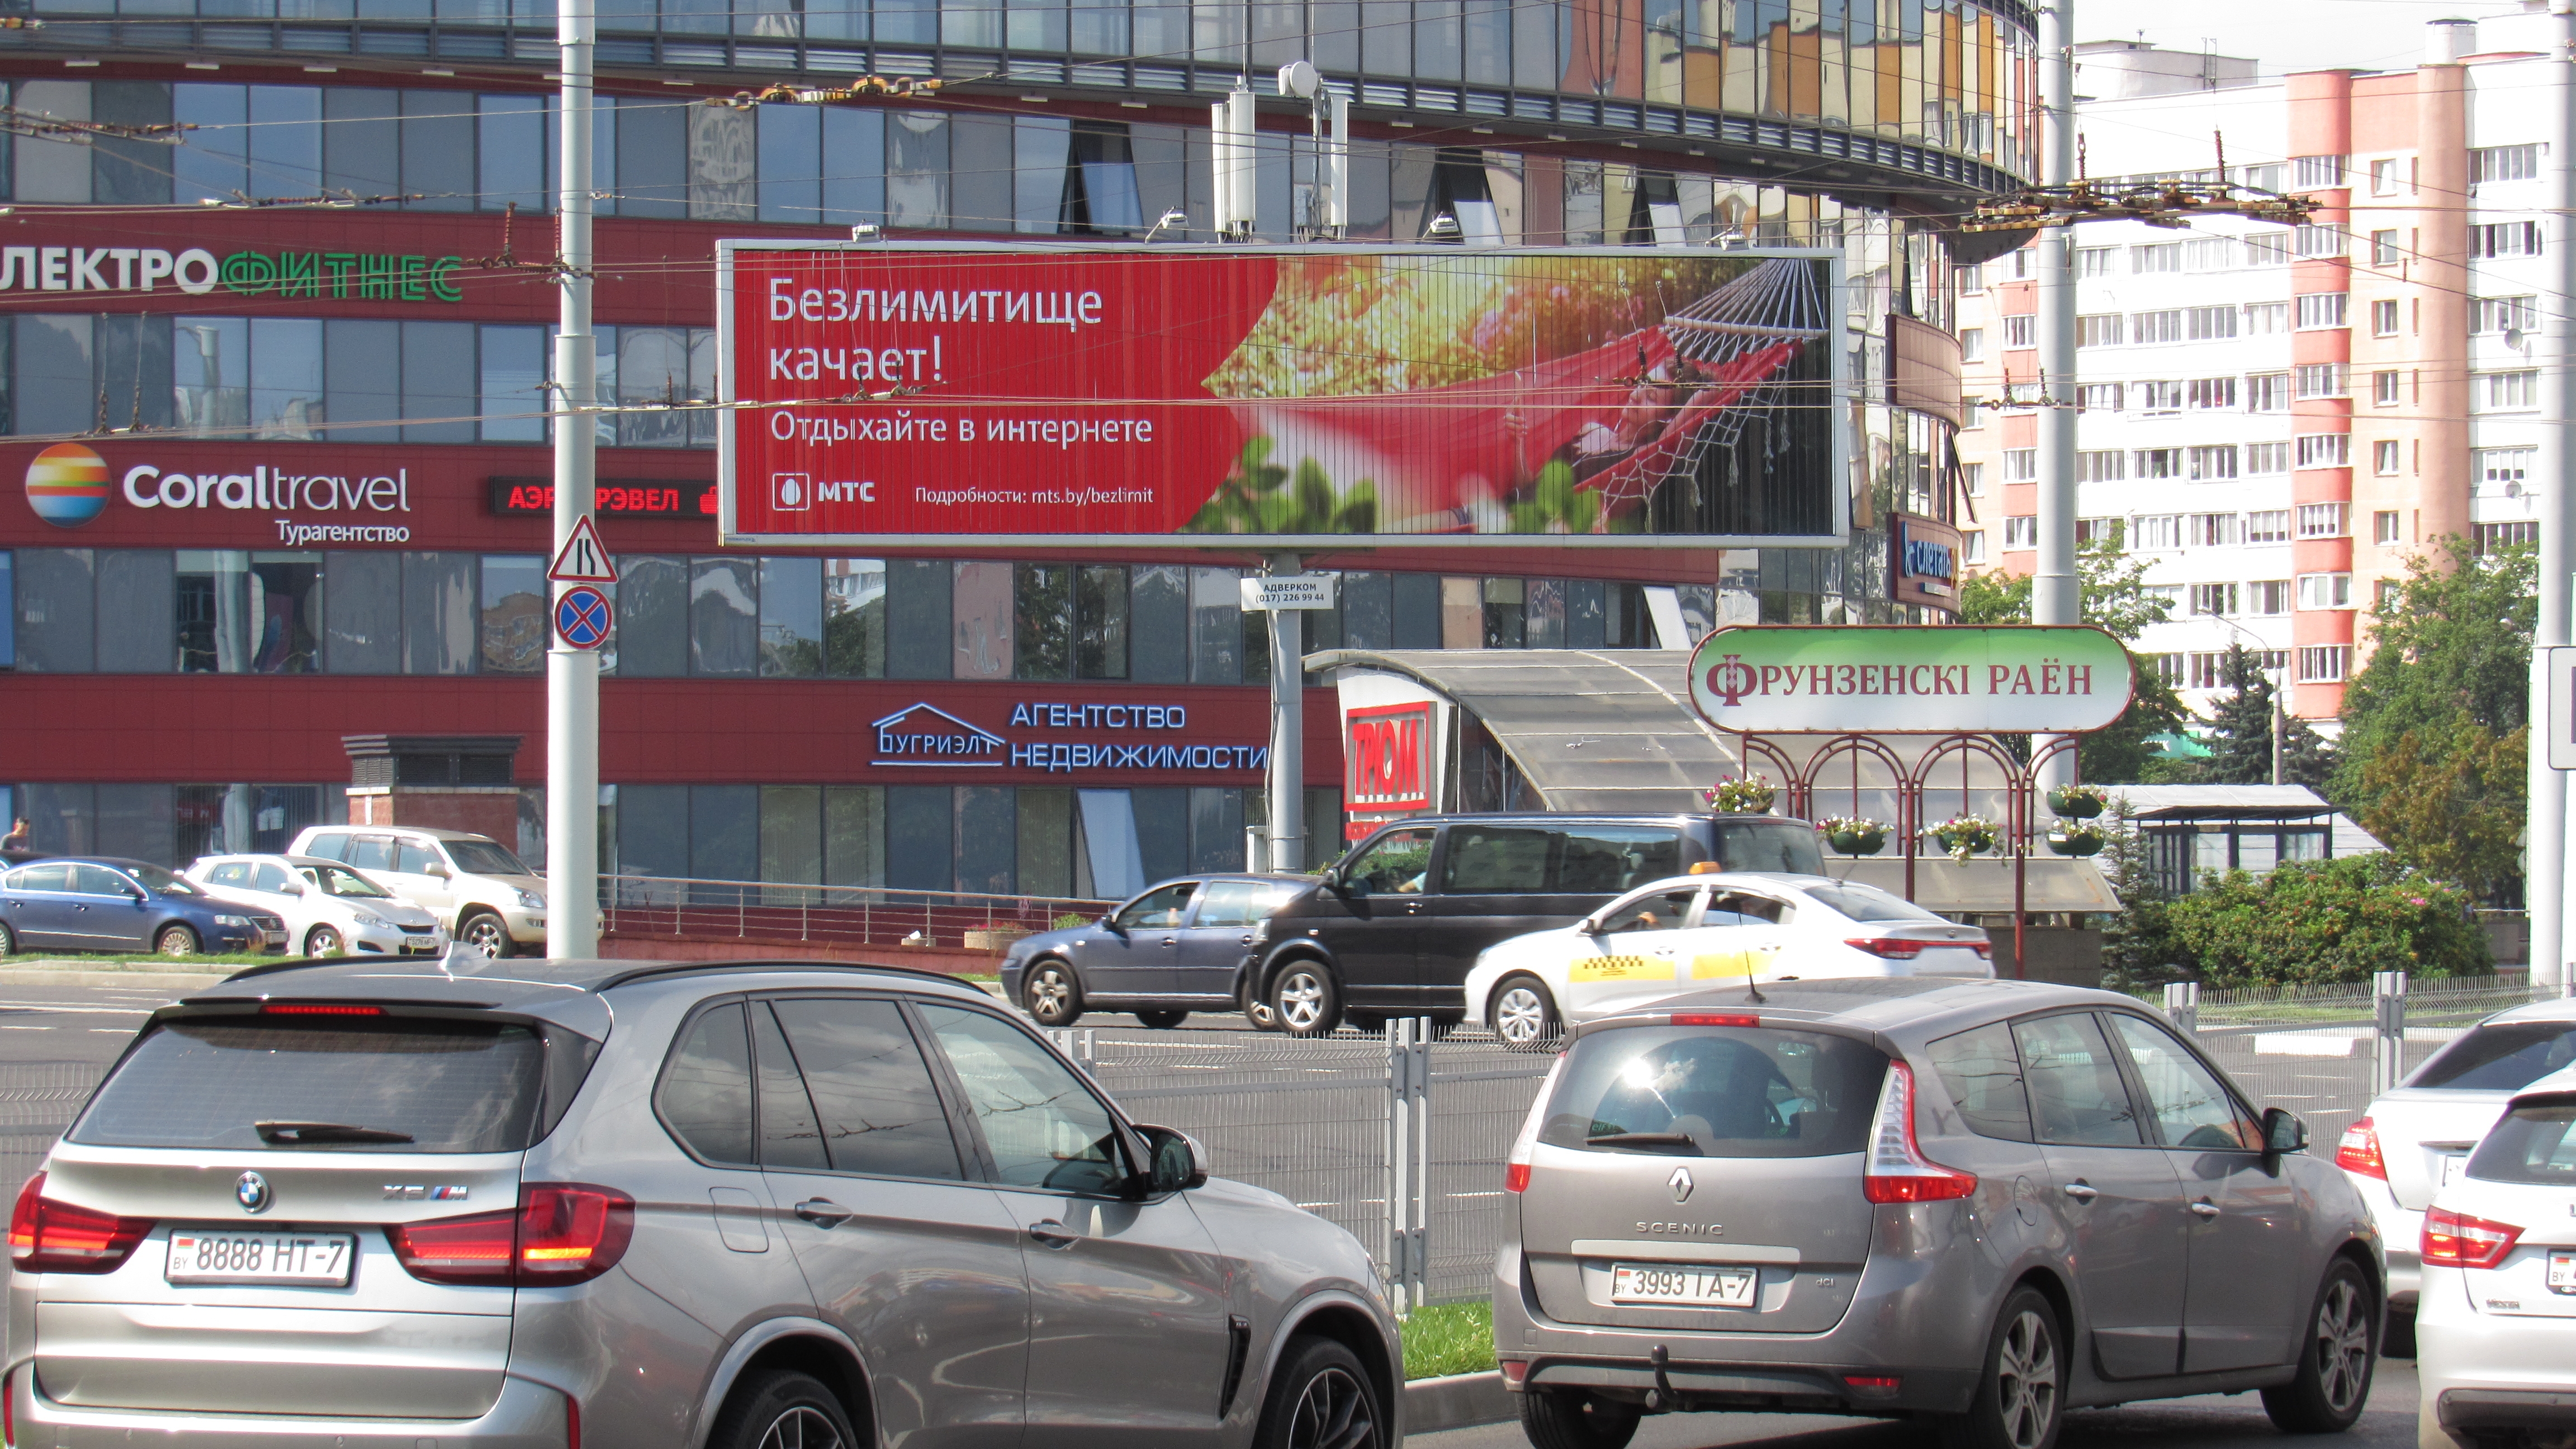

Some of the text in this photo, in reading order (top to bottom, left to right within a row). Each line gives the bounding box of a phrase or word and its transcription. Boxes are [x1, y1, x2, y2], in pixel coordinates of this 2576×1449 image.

[770, 277, 1103, 333] Безлимитище
[770, 335, 941, 382] качает!
[771, 410, 1153, 450] Отдыхайте в интернете
[915, 486, 1154, 506] Подробности: mts.by/bezlimit
[274, 520, 410, 546] Турагентство
[1256, 594, 1281, 604] (017)
[1283, 593, 1300, 602] 226
[1314, 593, 1325, 602] 44
[1263, 583, 1317, 593] АДВЕРКОМ
[1706, 654, 2092, 706] ФРУНЗЕНСКІ РАЁН
[1010, 703, 1186, 728] АГЕНТСТВО
[1011, 742, 1268, 773] НЕДВИЖИМОСТИ
[1636, 1221, 1723, 1235] SCENIC
[173, 1257, 188, 1270] BY
[197, 1238, 345, 1273] 8888 HT-7
[1633, 1270, 1685, 1295] 3993
[2551, 1271, 2565, 1282] BY
